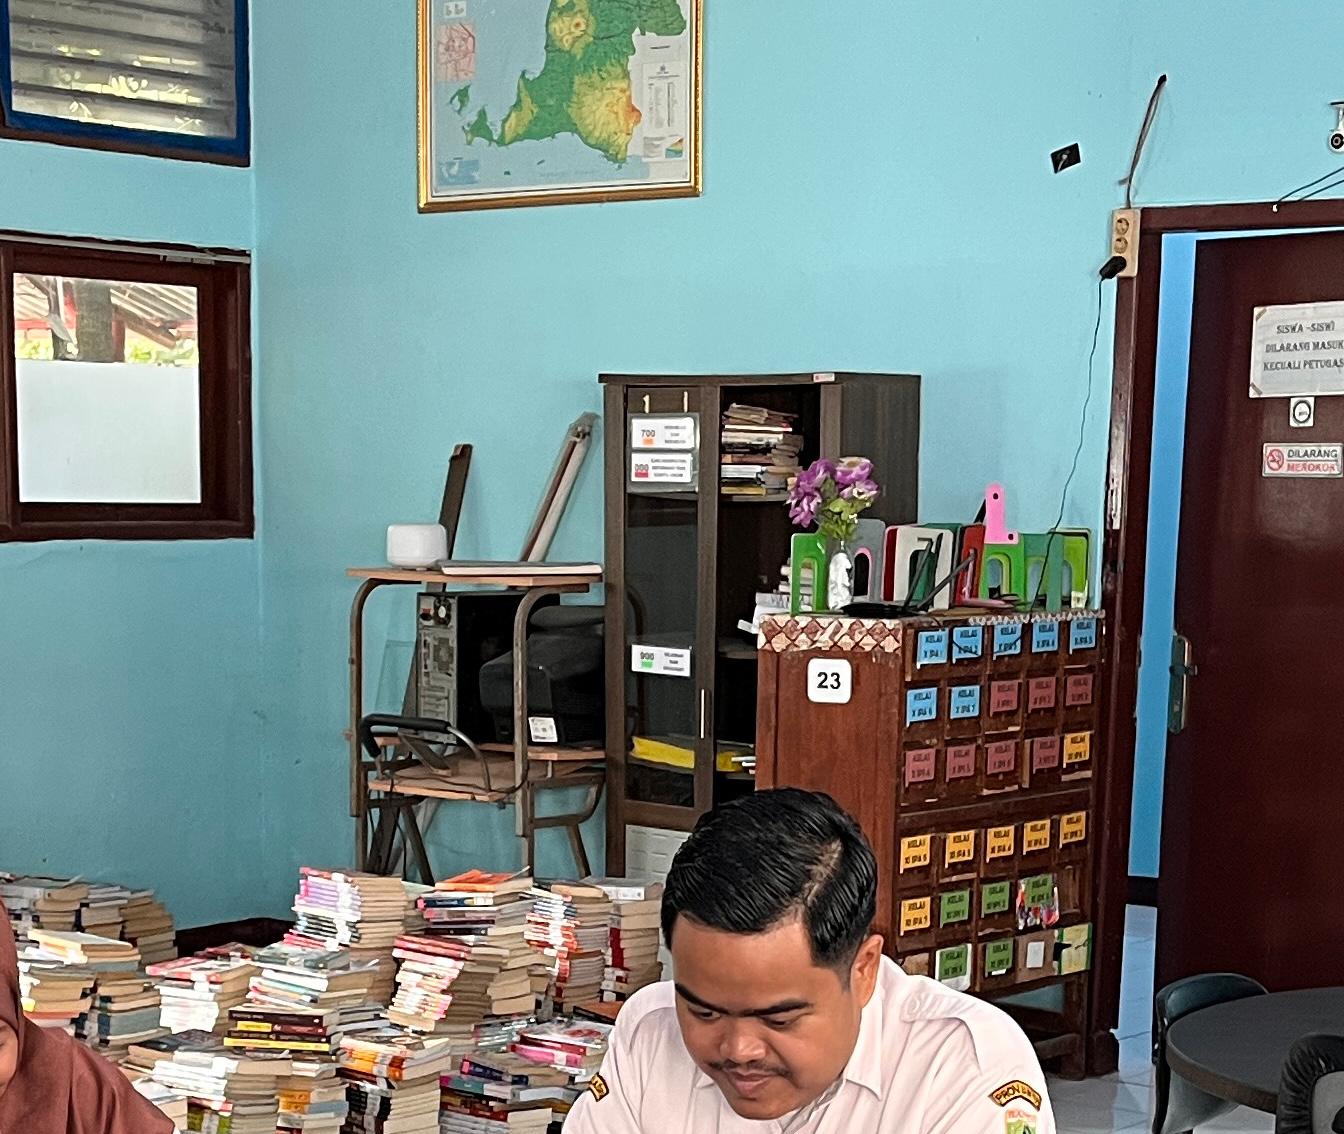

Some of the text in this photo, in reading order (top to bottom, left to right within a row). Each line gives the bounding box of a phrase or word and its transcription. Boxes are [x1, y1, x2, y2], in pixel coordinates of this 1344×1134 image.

[1265, 339, 1344, 354] DILARANG MASUK
[1263, 358, 1344, 372] KECUALI PETUGAS
[1287, 449, 1338, 459] DILARANG
[817, 671, 841, 690] 23
